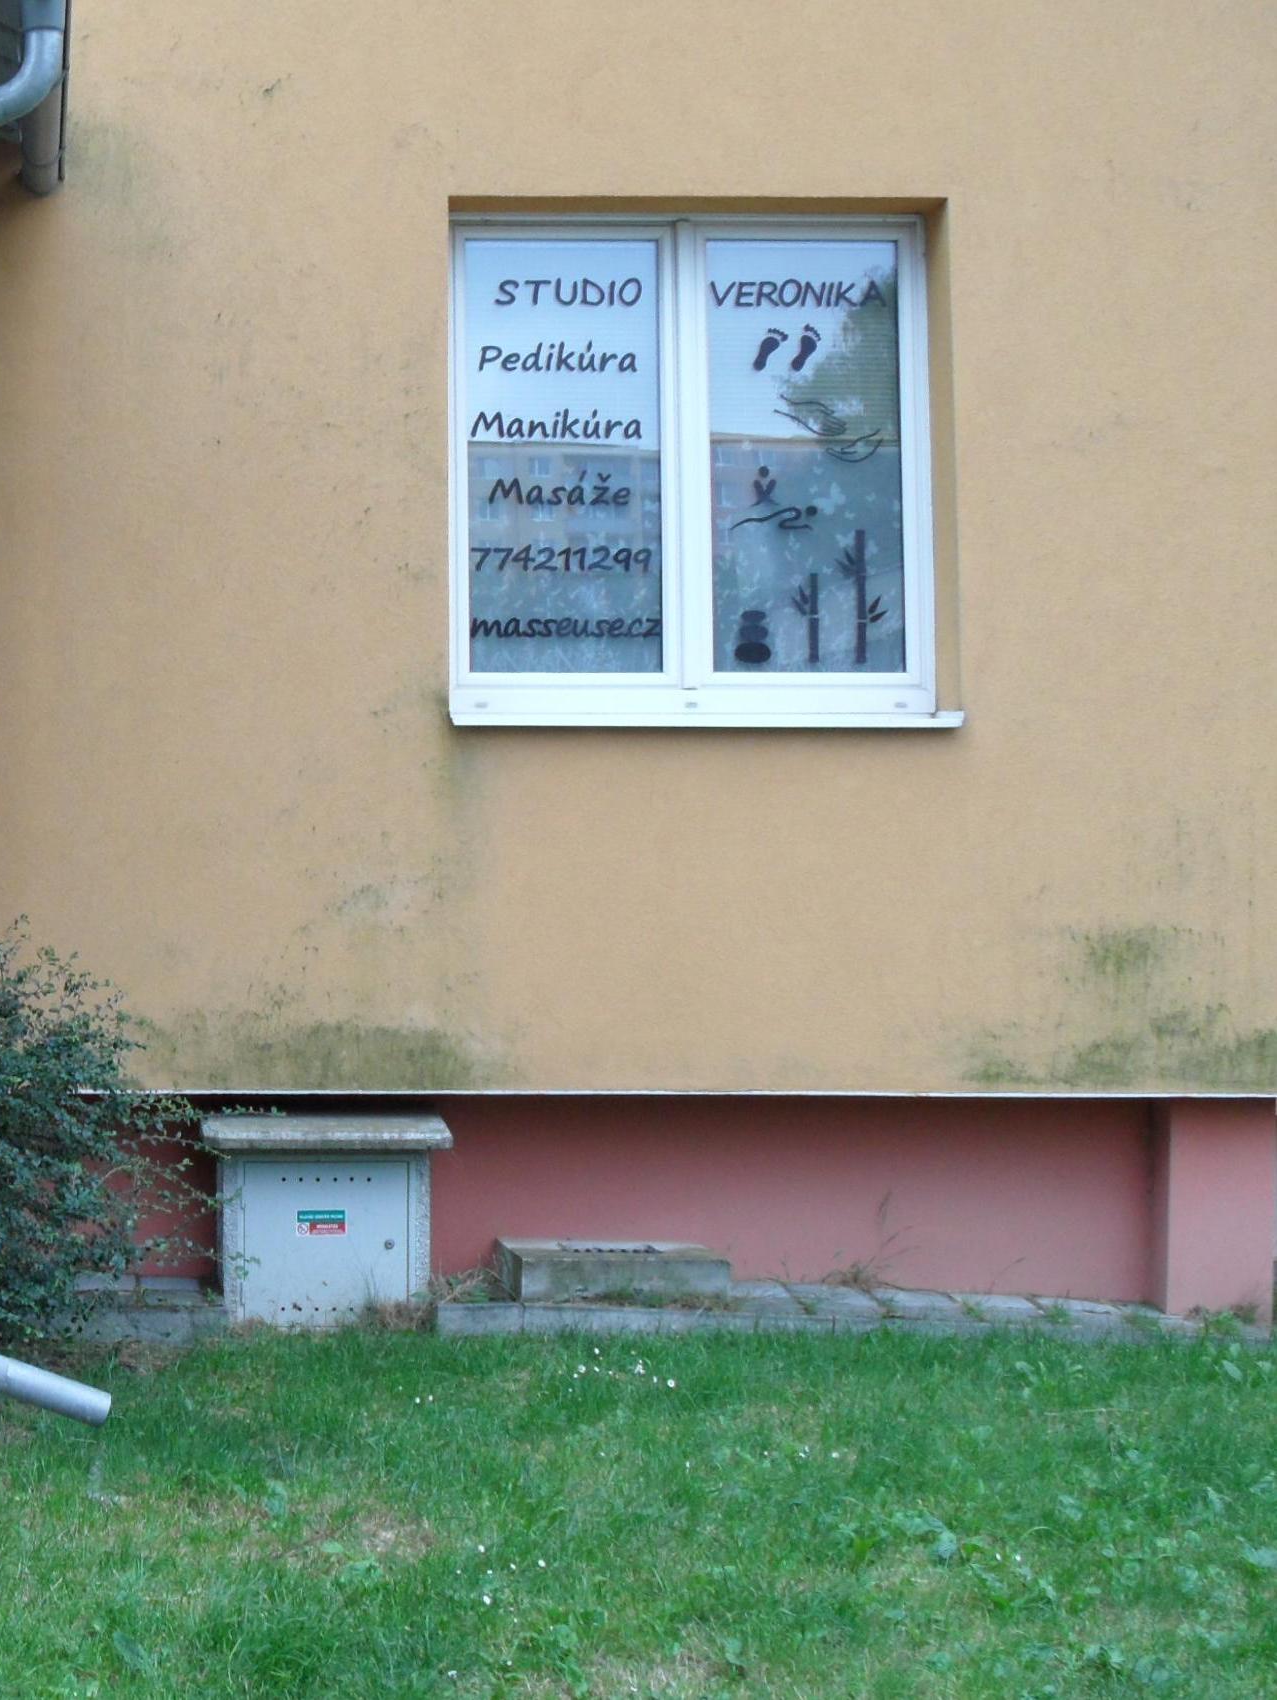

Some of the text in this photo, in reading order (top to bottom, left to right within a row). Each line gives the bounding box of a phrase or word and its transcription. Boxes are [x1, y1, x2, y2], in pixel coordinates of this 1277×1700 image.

[495, 278, 888, 308] STUDIO VERONIKA
[477, 340, 638, 373] Pedikúra
[470, 408, 644, 440] Manikúra
[488, 472, 632, 507] Masáže
[470, 545, 653, 573] 774211299
